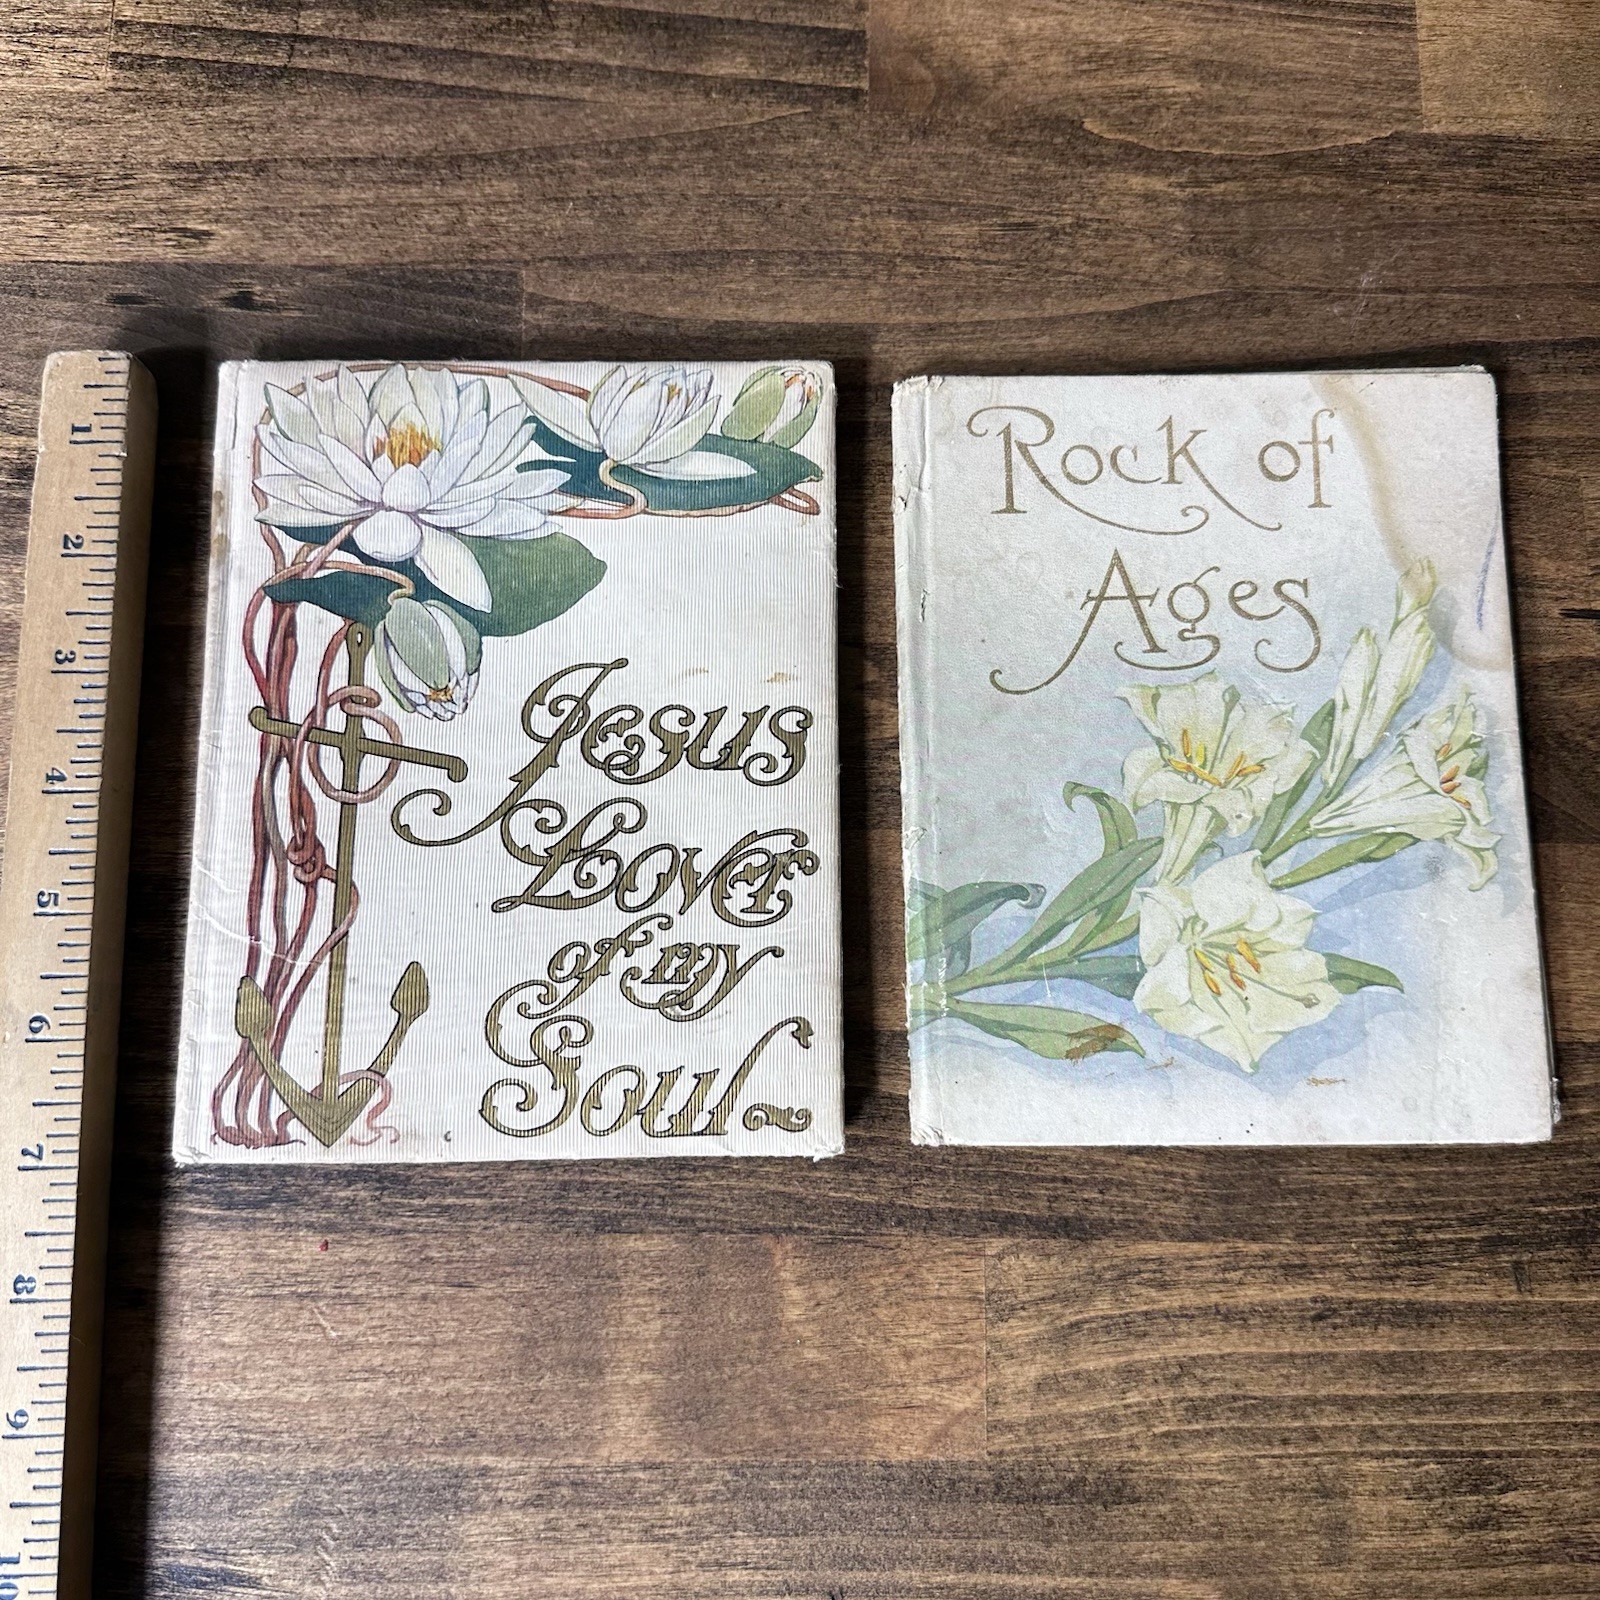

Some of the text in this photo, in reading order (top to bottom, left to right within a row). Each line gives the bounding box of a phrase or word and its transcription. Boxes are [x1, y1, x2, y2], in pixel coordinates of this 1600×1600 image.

[70, 423, 93, 435] 1
[966, 405, 1335, 536] Rock of
[62, 534, 85, 551] 2
[989, 547, 1322, 696] Ages
[54, 648, 77, 665] 3
[391, 657, 814, 847] Jesus
[45, 766, 68, 785] 4
[491, 796, 821, 928] Lover
[37, 889, 60, 909] 5
[518, 912, 785, 1023] of my
[28, 1014, 51, 1034] 6
[478, 979, 813, 1138] Soul
[21, 1142, 44, 1161] 7
[13, 1273, 37, 1295] 8
[6, 1408, 29, 1431] 9
